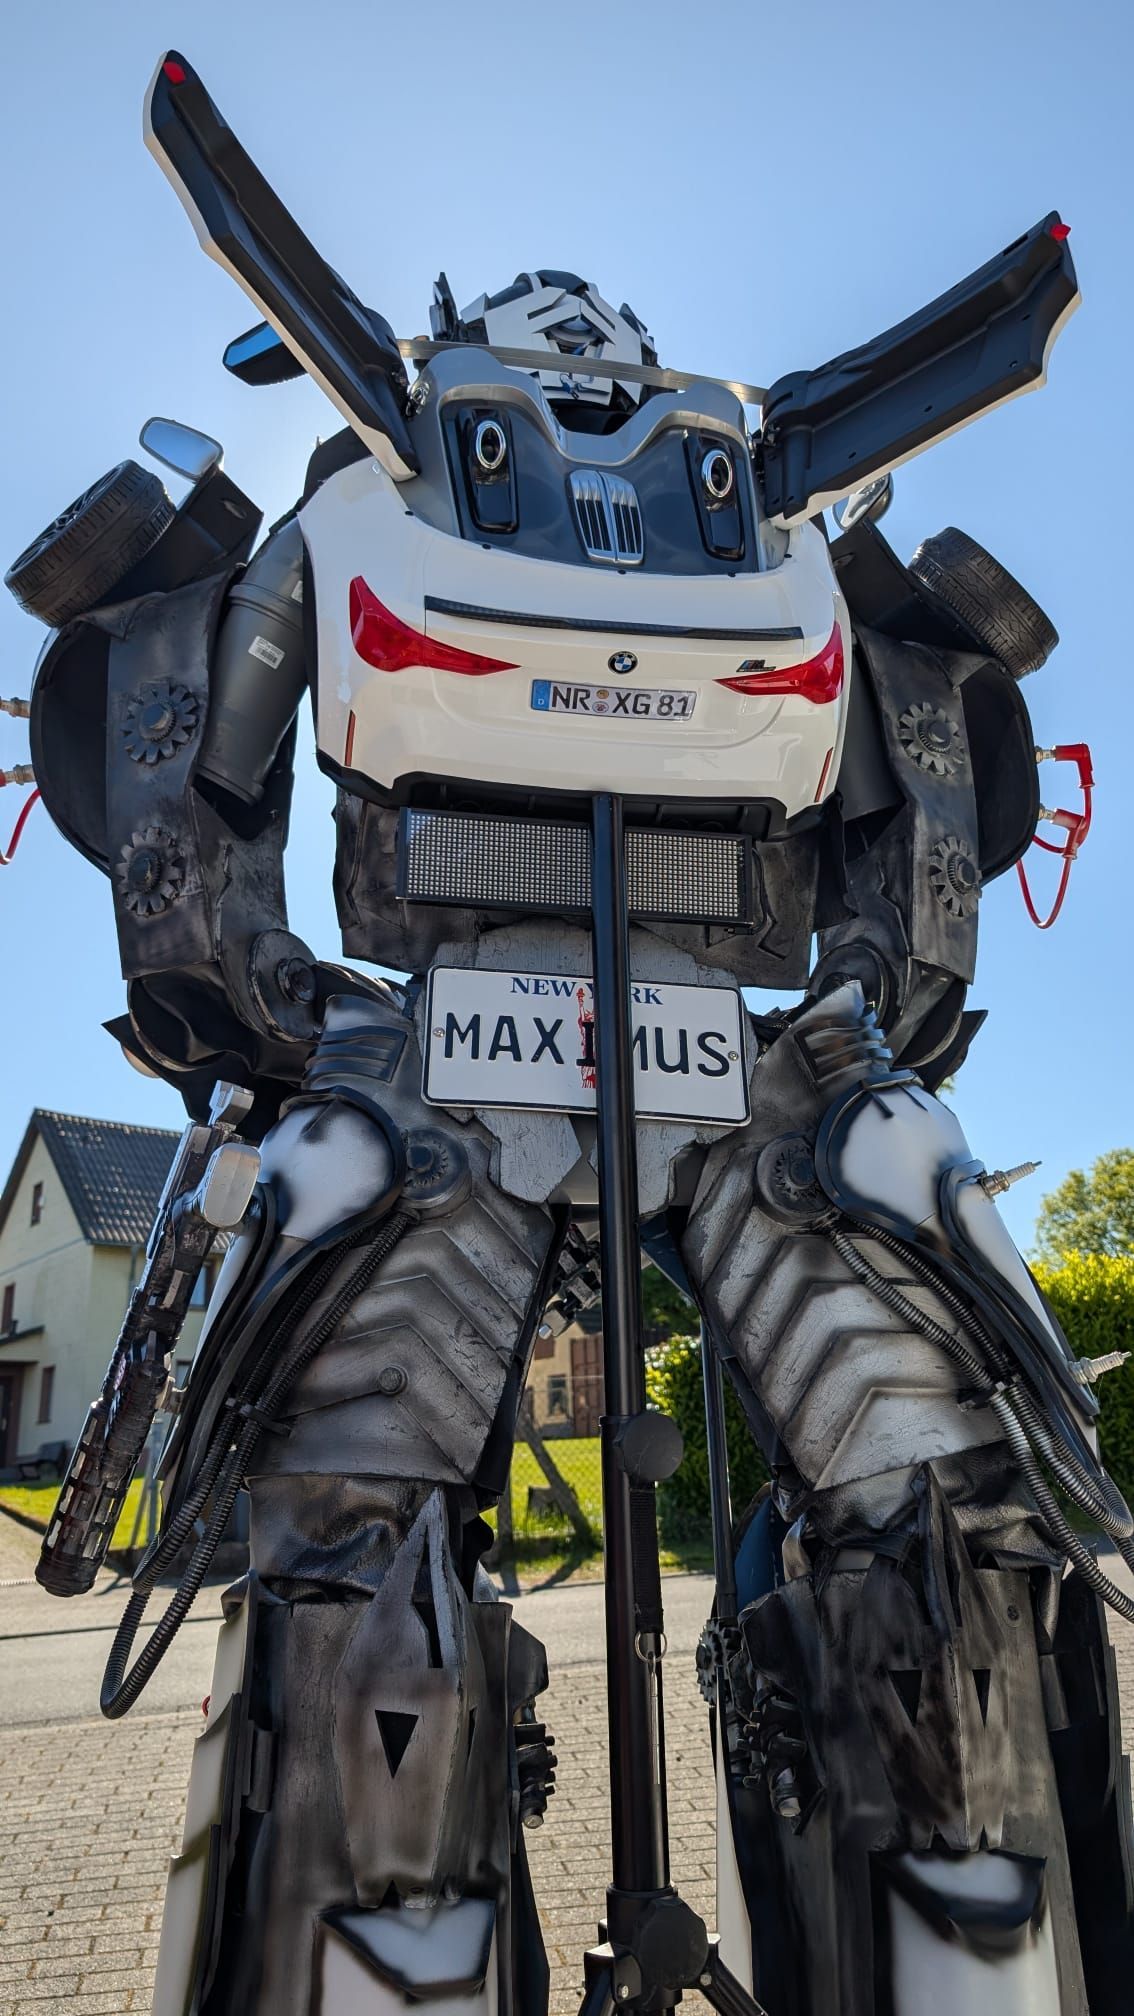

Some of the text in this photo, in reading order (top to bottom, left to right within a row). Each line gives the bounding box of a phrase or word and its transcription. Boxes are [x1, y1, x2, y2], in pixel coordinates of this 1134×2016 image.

[551, 686, 690, 718] NR XG 81
[510, 977, 663, 1005] NEW YRK
